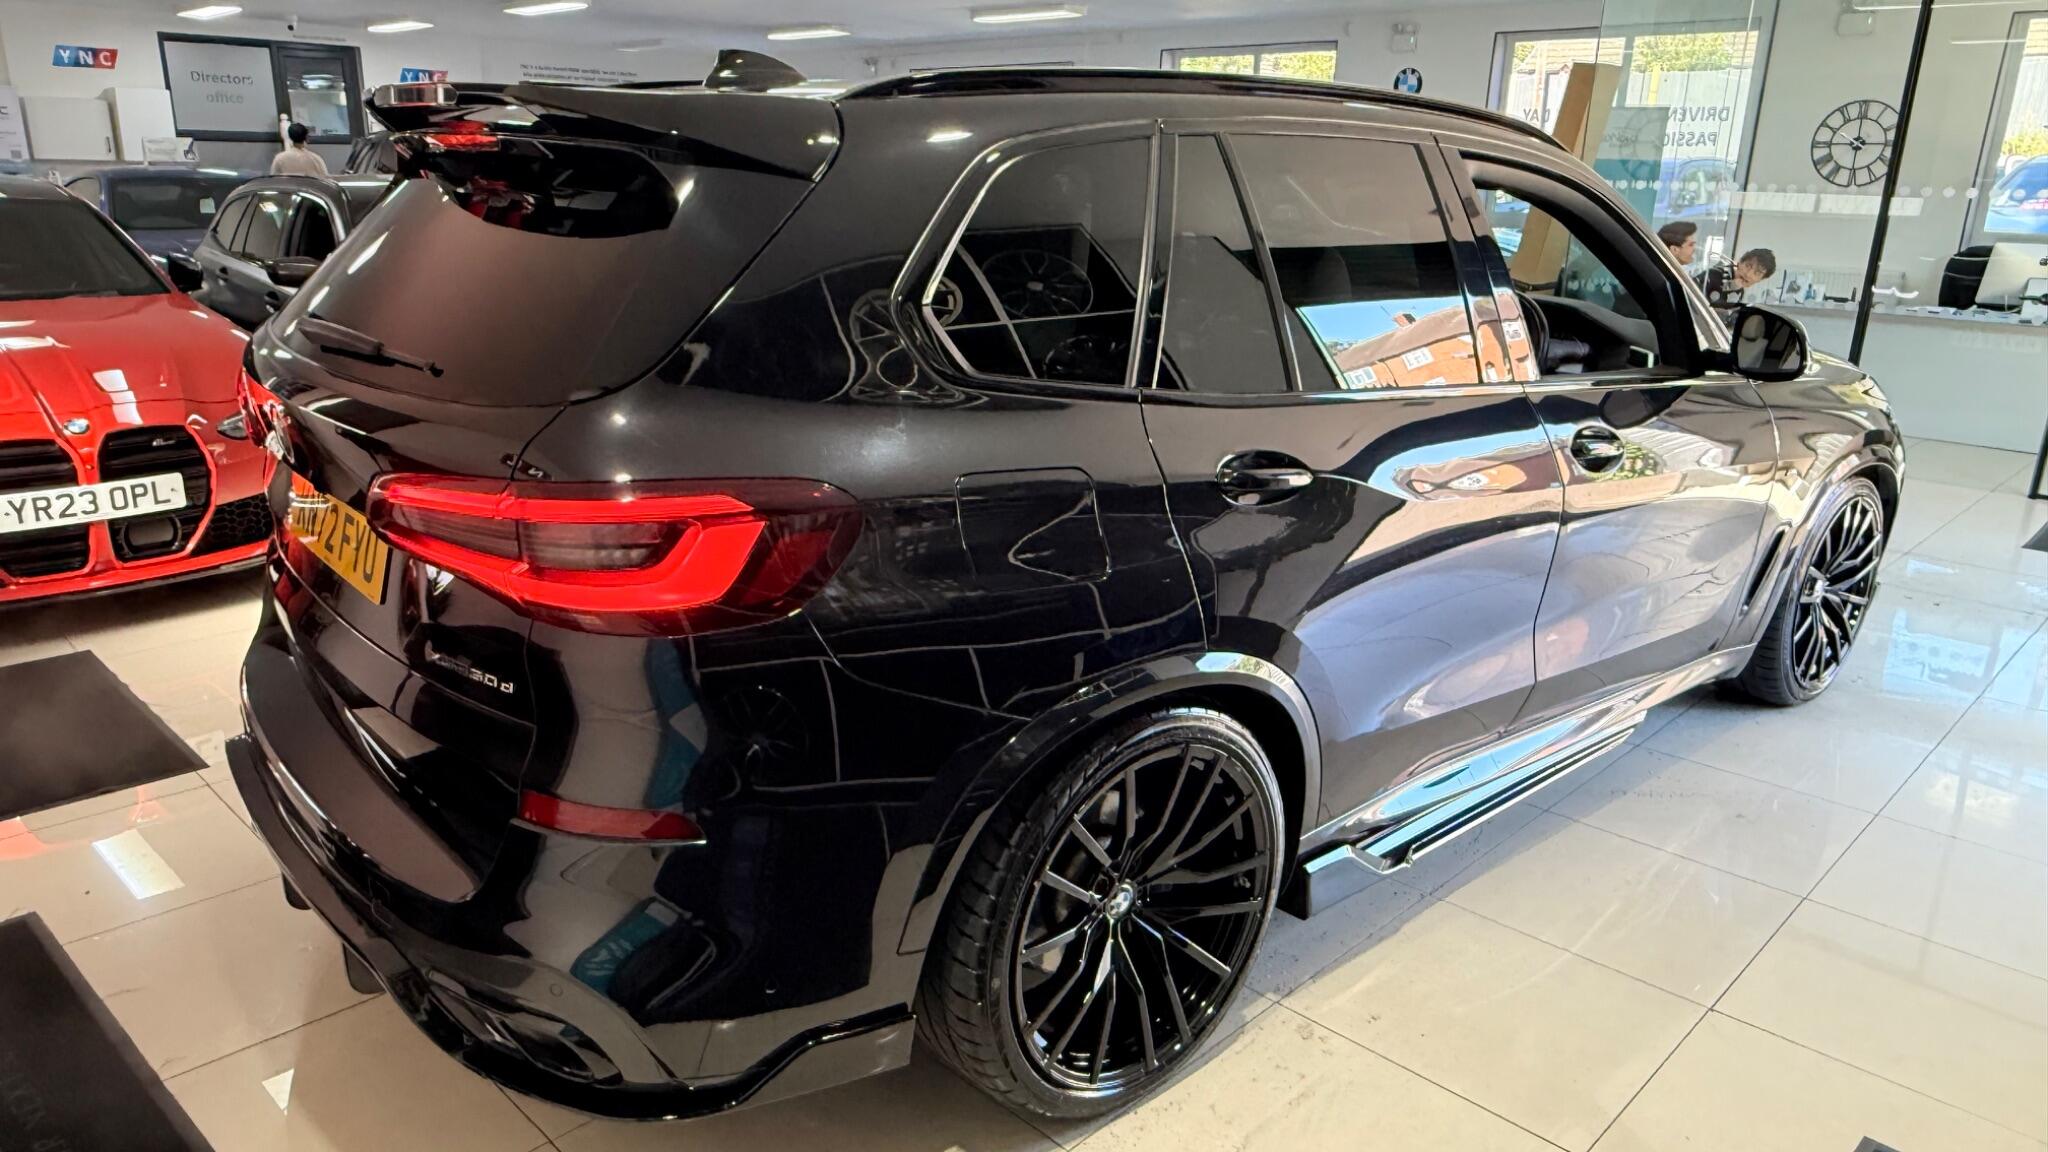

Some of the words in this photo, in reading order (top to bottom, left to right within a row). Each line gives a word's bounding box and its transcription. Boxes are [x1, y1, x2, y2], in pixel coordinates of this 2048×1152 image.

[59, 48, 112, 66] YNC
[190, 70, 254, 85] Directors
[404, 71, 443, 83] YNC
[7, 490, 99, 524] YR23
[109, 481, 171, 511] OPL
[339, 511, 379, 584] FYU
